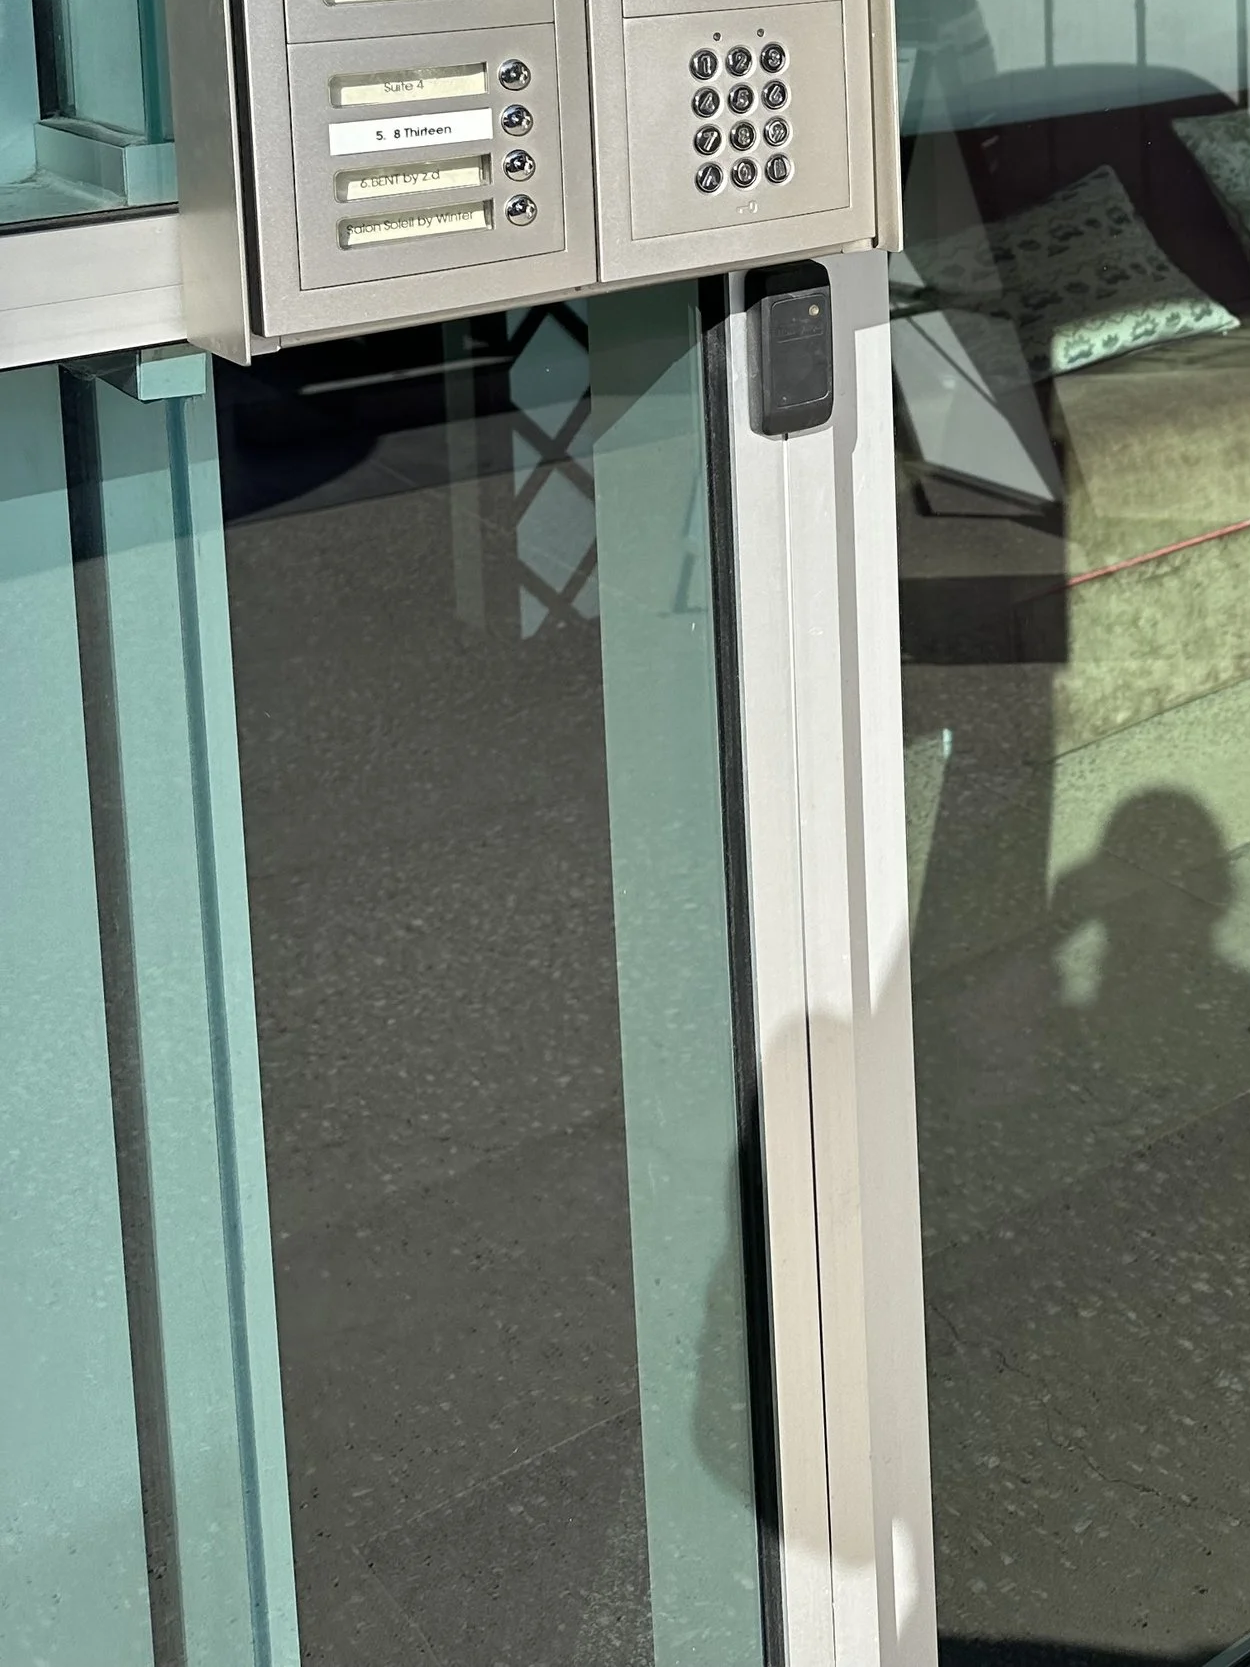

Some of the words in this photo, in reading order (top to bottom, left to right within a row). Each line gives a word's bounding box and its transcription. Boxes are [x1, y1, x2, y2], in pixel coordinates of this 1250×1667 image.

[384, 80, 413, 93] Suite
[416, 80, 425, 90] 4
[375, 130, 386, 141] 5.
[393, 129, 401, 139] 8
[403, 125, 452, 138] Thirteen
[403, 172, 419, 186] by
[417, 215, 434, 227] by
[436, 211, 474, 224] Winter
